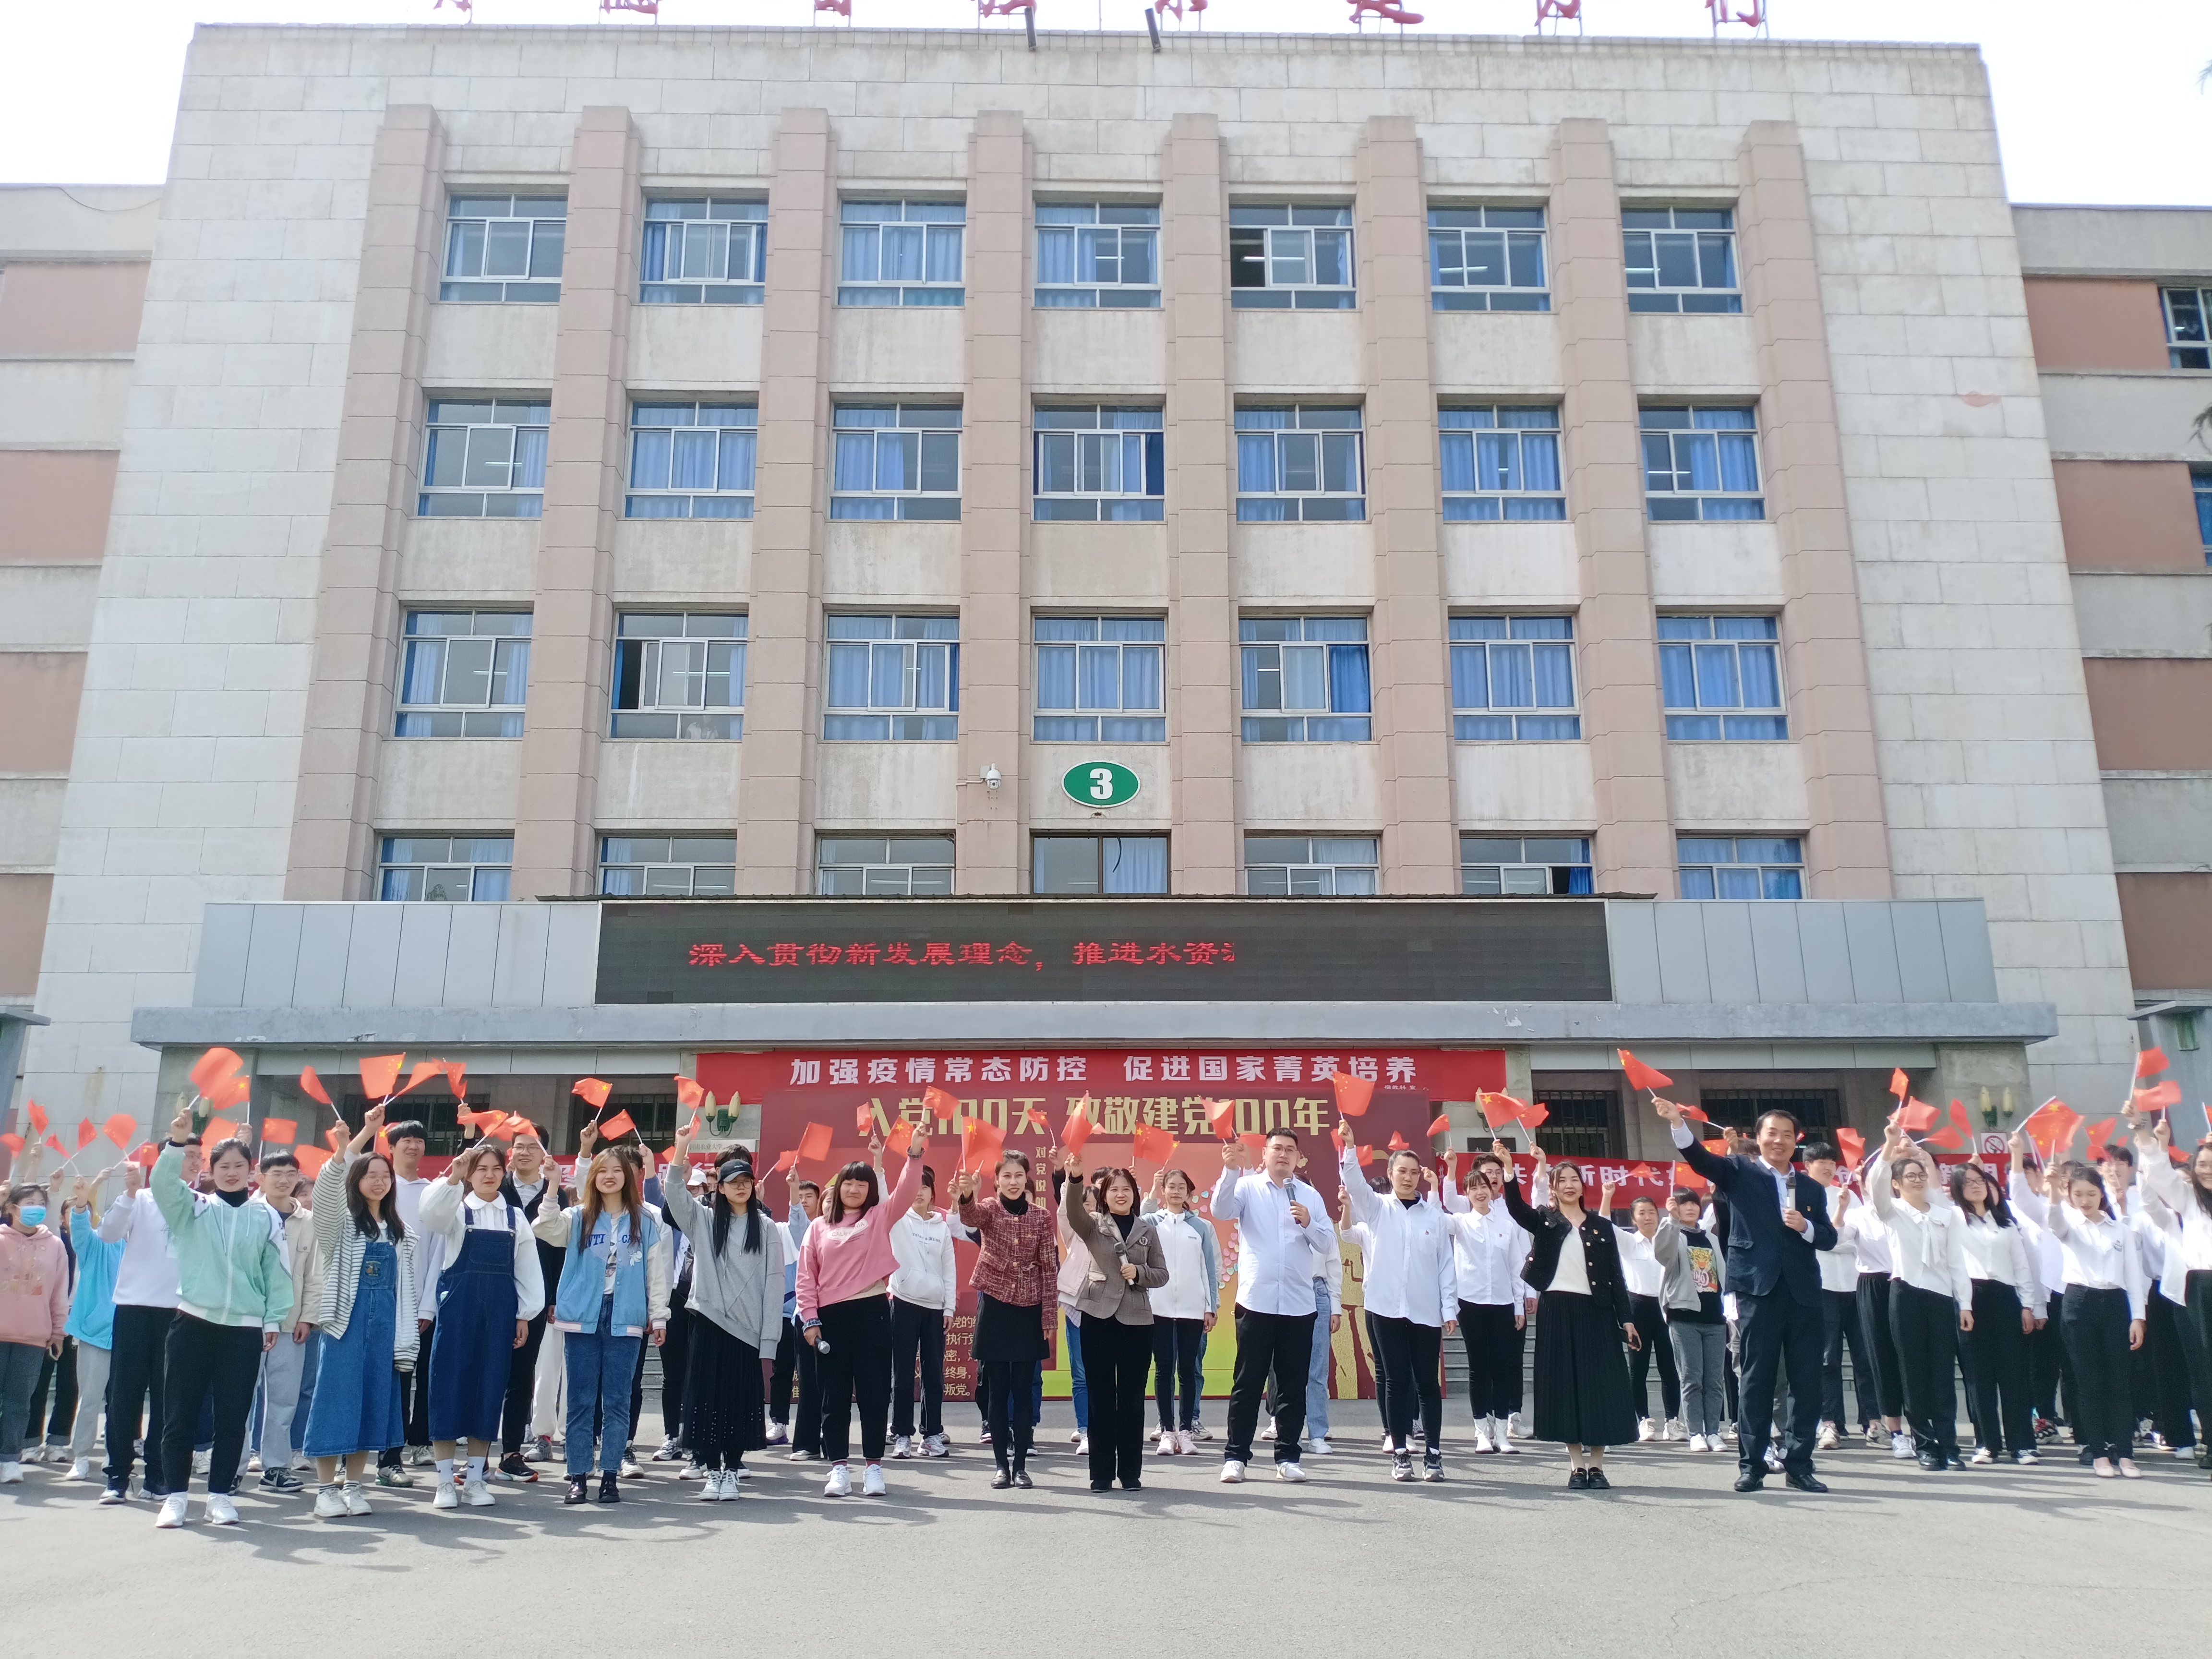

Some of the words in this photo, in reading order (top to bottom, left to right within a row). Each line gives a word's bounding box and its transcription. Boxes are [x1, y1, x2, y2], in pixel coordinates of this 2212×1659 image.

[1090, 768, 1113, 800] 3
[790, 1056, 1086, 1085] 加强疫情常态防控
[1123, 1055, 1417, 1083] 促进国家菁英培养
[1066, 1096, 1330, 1135] 致敬建党00年
[952, 1315, 976, 1328] 党的
